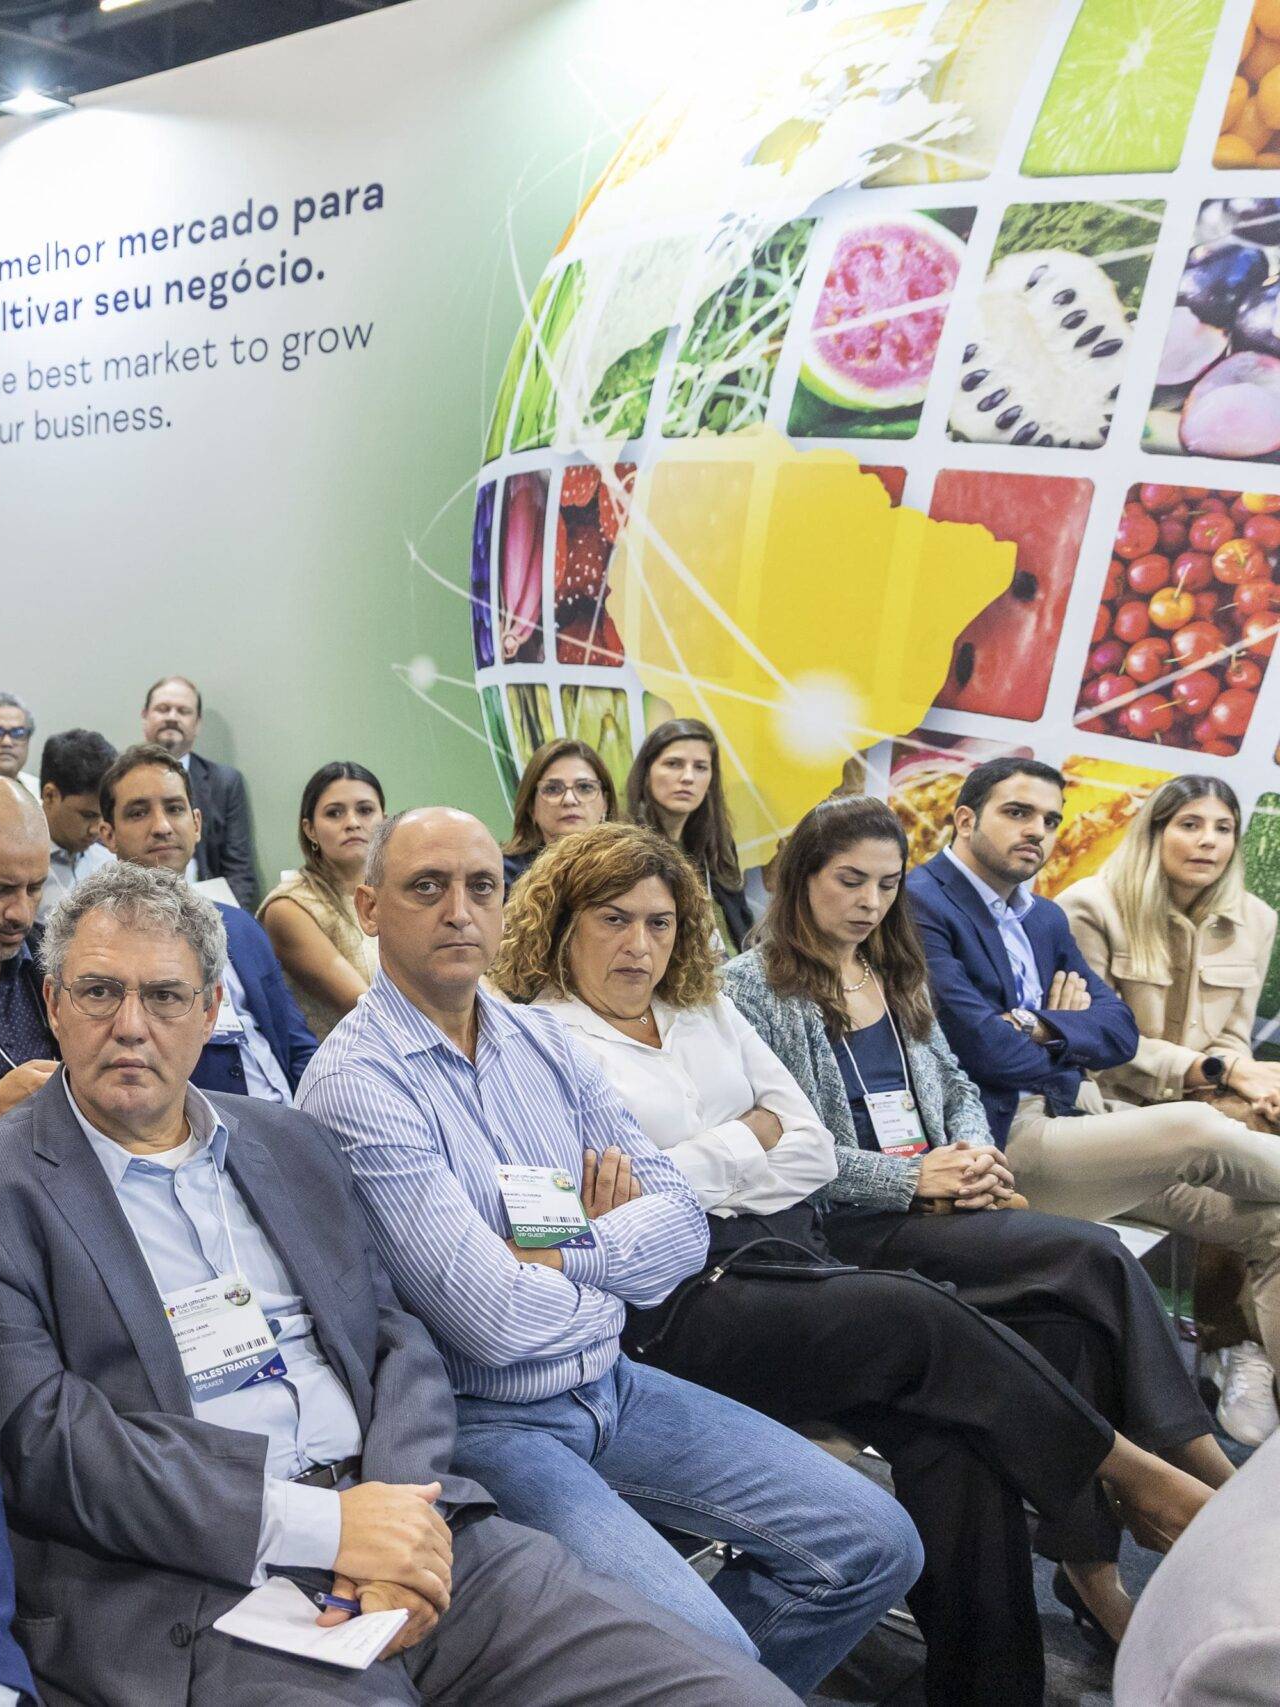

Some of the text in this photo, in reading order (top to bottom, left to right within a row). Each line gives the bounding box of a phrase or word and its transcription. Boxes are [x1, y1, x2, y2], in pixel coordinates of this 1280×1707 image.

[119, 198, 279, 258] mercado
[293, 182, 385, 235] para
[94, 283, 152, 317] seu
[164, 250, 325, 310] negócio.
[27, 359, 93, 391] best
[104, 338, 218, 381] market
[230, 333, 269, 365] to
[282, 322, 374, 371] grow
[34, 404, 172, 441] business.
[516, 1225, 566, 1234] CONVIDADO
[191, 1355, 261, 1384] PALESTRANTE
